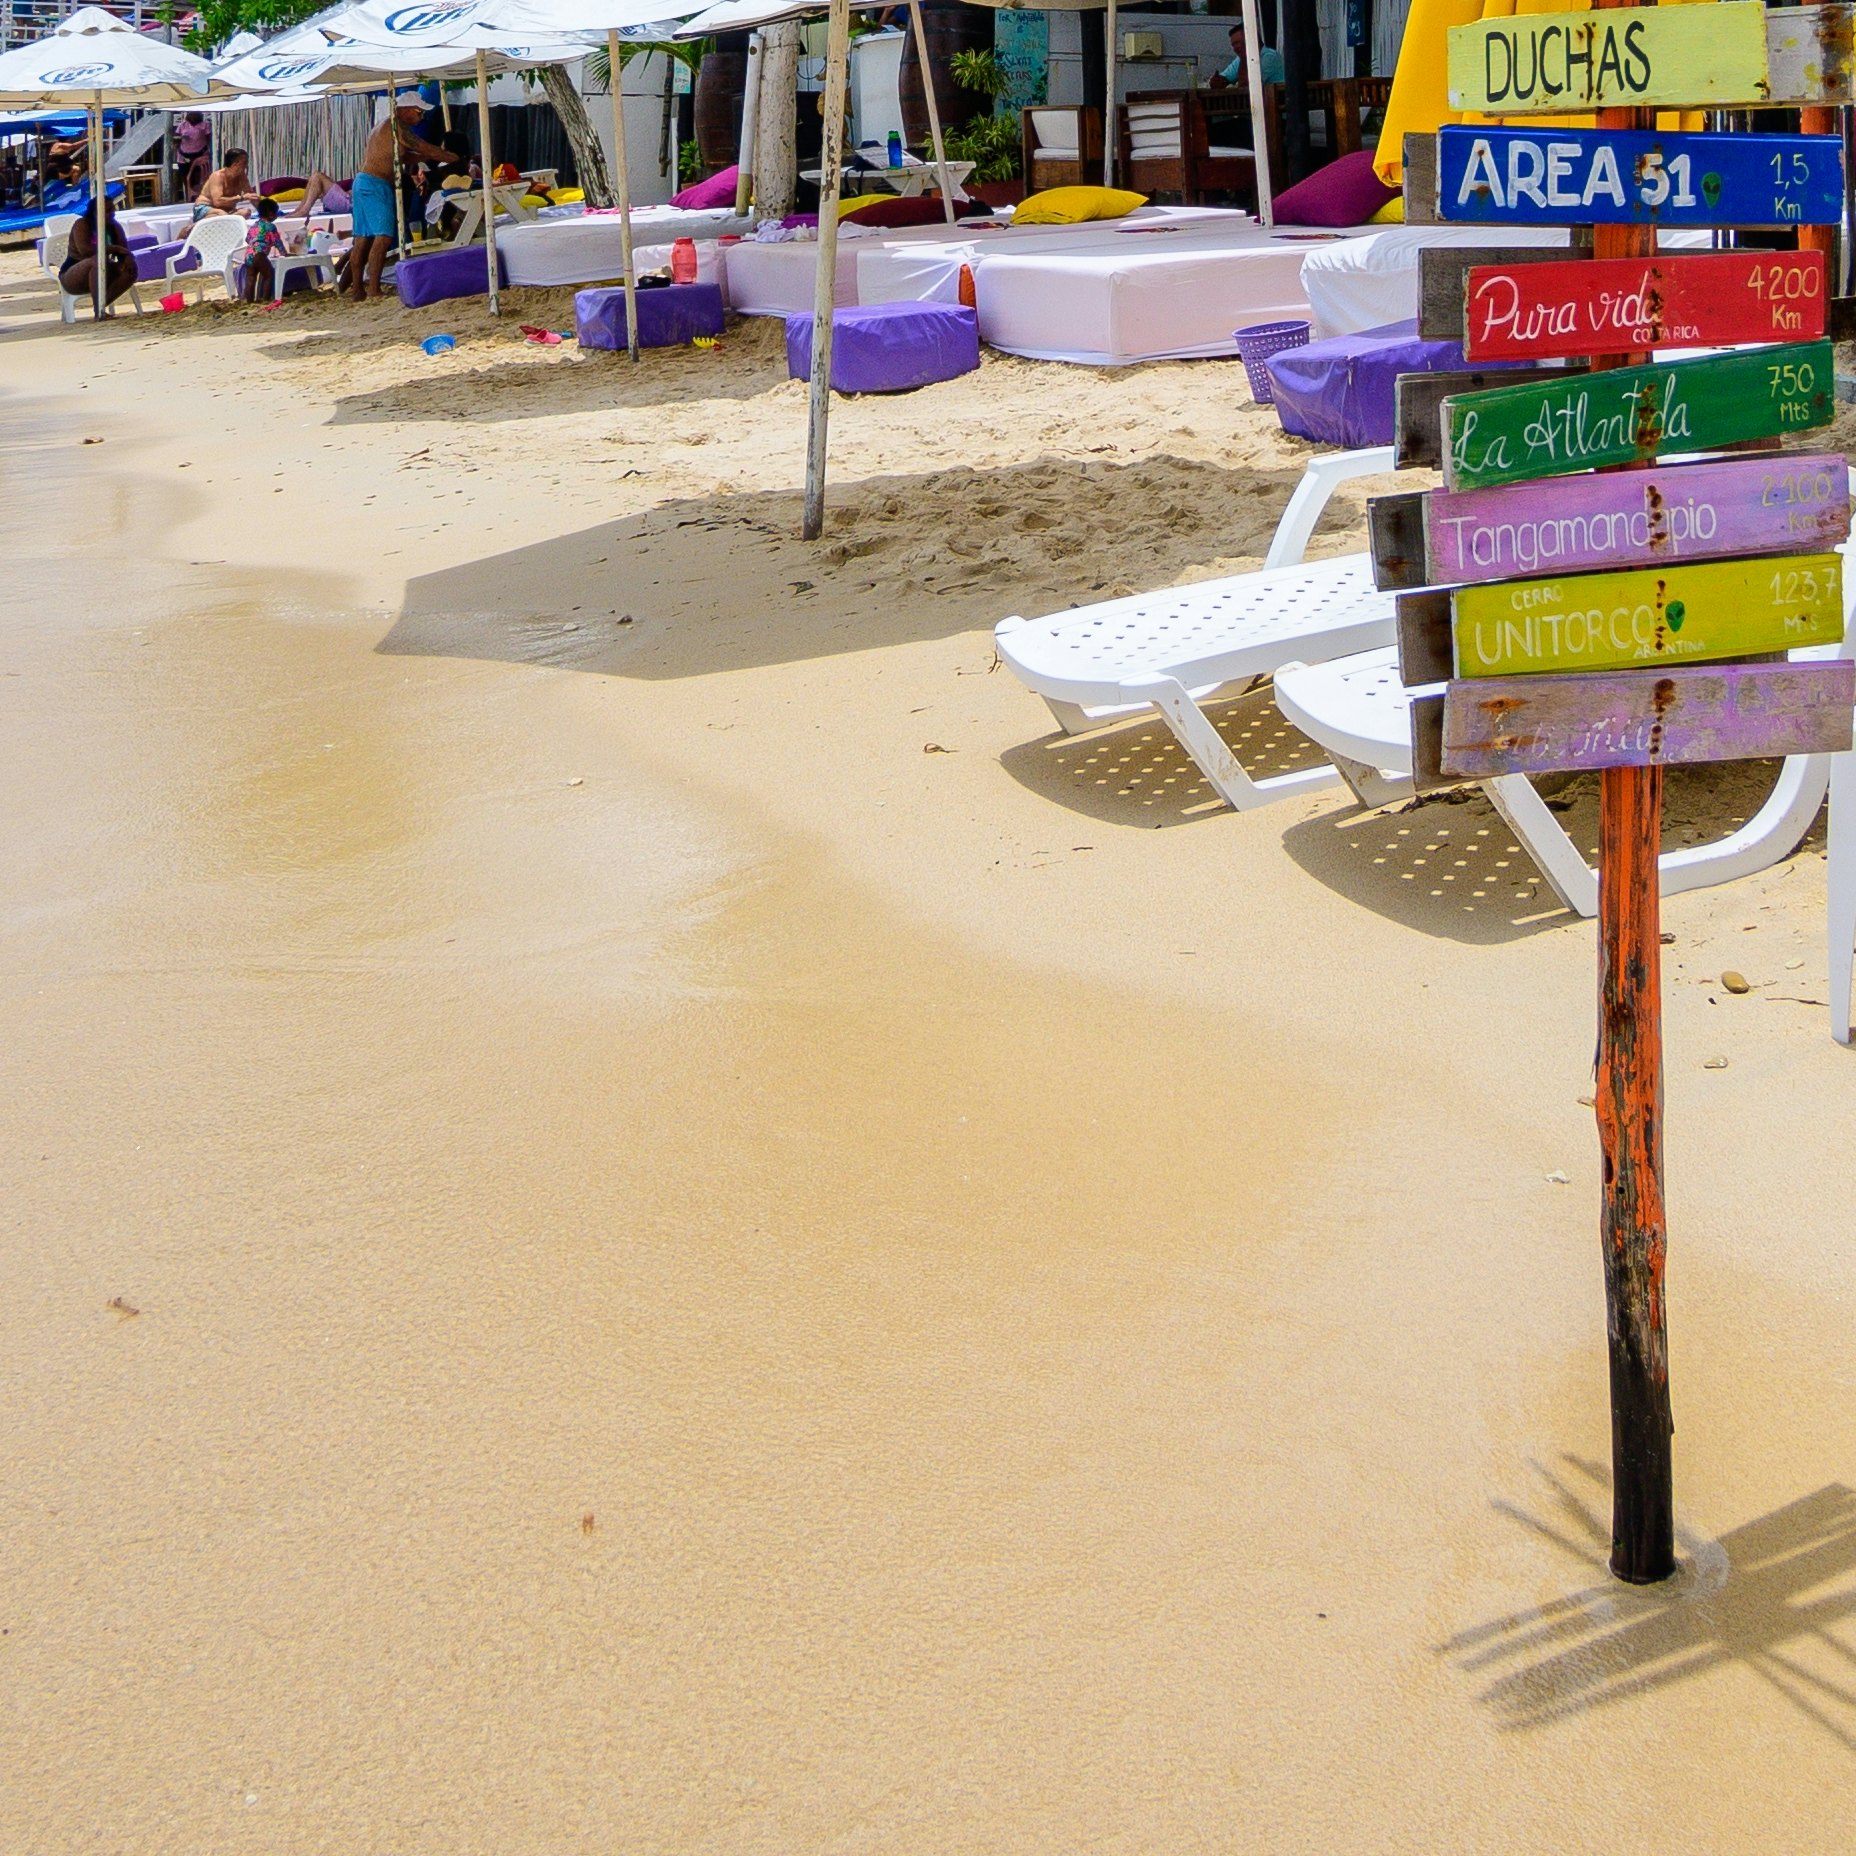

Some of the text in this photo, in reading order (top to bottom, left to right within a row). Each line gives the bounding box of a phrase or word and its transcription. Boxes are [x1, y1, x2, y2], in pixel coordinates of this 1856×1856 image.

[1486, 21, 1652, 103] DUCHAS
[1456, 138, 1697, 209] AREA 51
[1769, 152, 1810, 192] 1,5
[1773, 195, 1802, 221] Km
[1475, 275, 1578, 344] Pura
[1771, 304, 1803, 331] Km
[1632, 324, 1701, 344] COTA RICA
[1766, 362, 1816, 398] 750
[1451, 372, 1693, 475] La Atlantda
[1510, 584, 1564, 612] CERRO
[1769, 566, 1838, 607] 123.7
[1475, 603, 1656, 667] UNITORCO
